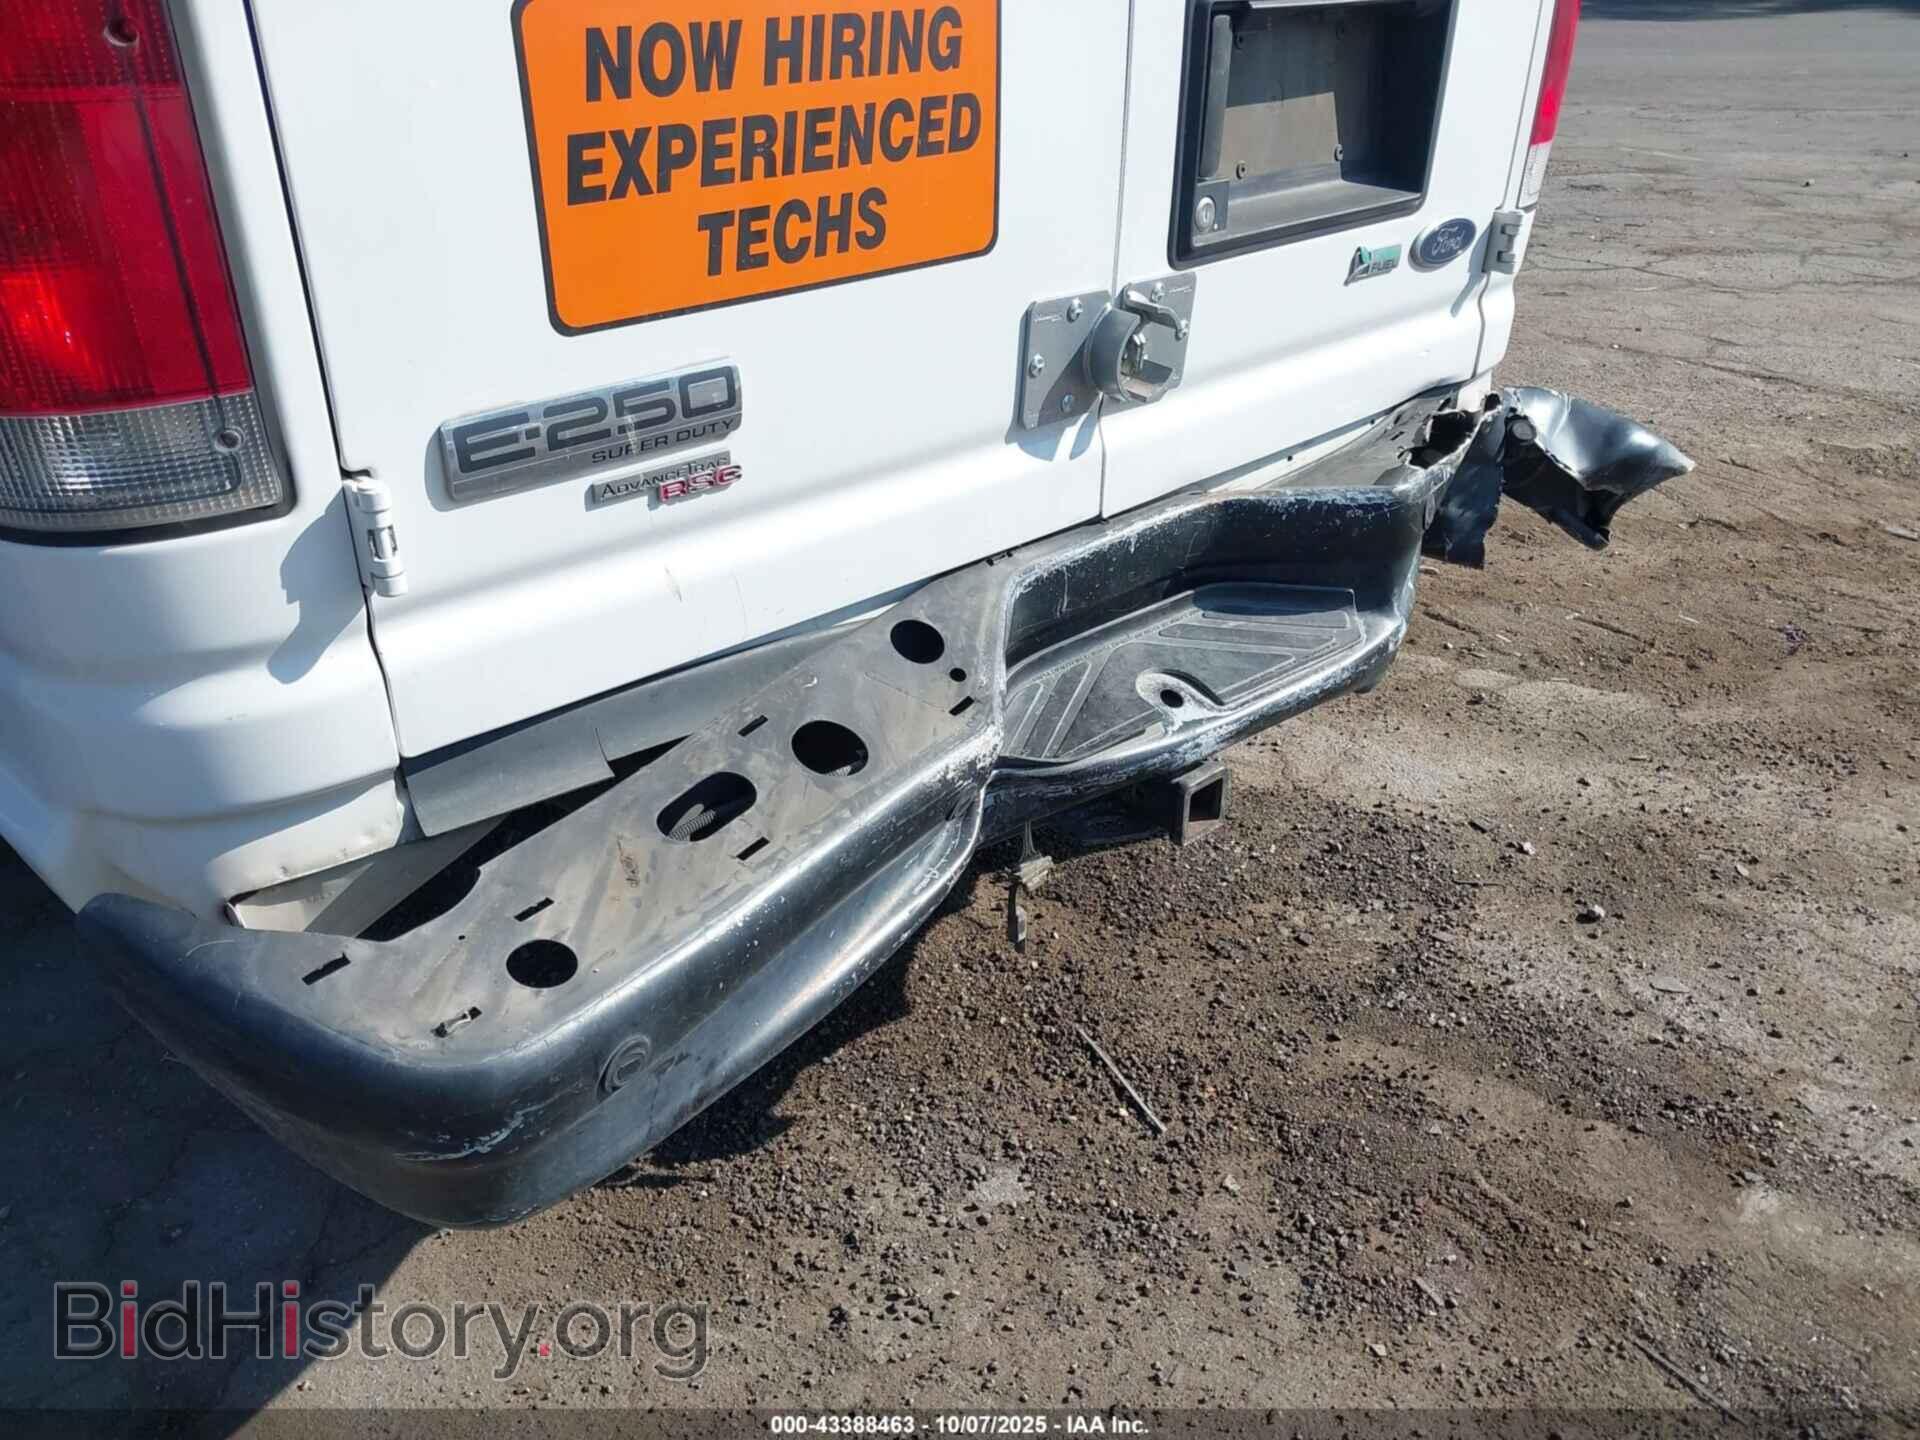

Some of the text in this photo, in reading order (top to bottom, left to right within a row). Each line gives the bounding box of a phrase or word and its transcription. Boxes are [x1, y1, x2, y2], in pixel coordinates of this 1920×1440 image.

[585, 6, 963, 103] NOW HIRING
[566, 92, 982, 206] EXPERIENCED
[697, 187, 888, 276] TECHS
[1371, 259, 1398, 272] FUEL
[452, 365, 736, 474] E-250
[592, 419, 733, 463] SUPER DUTY
[659, 464, 742, 503] RSC
